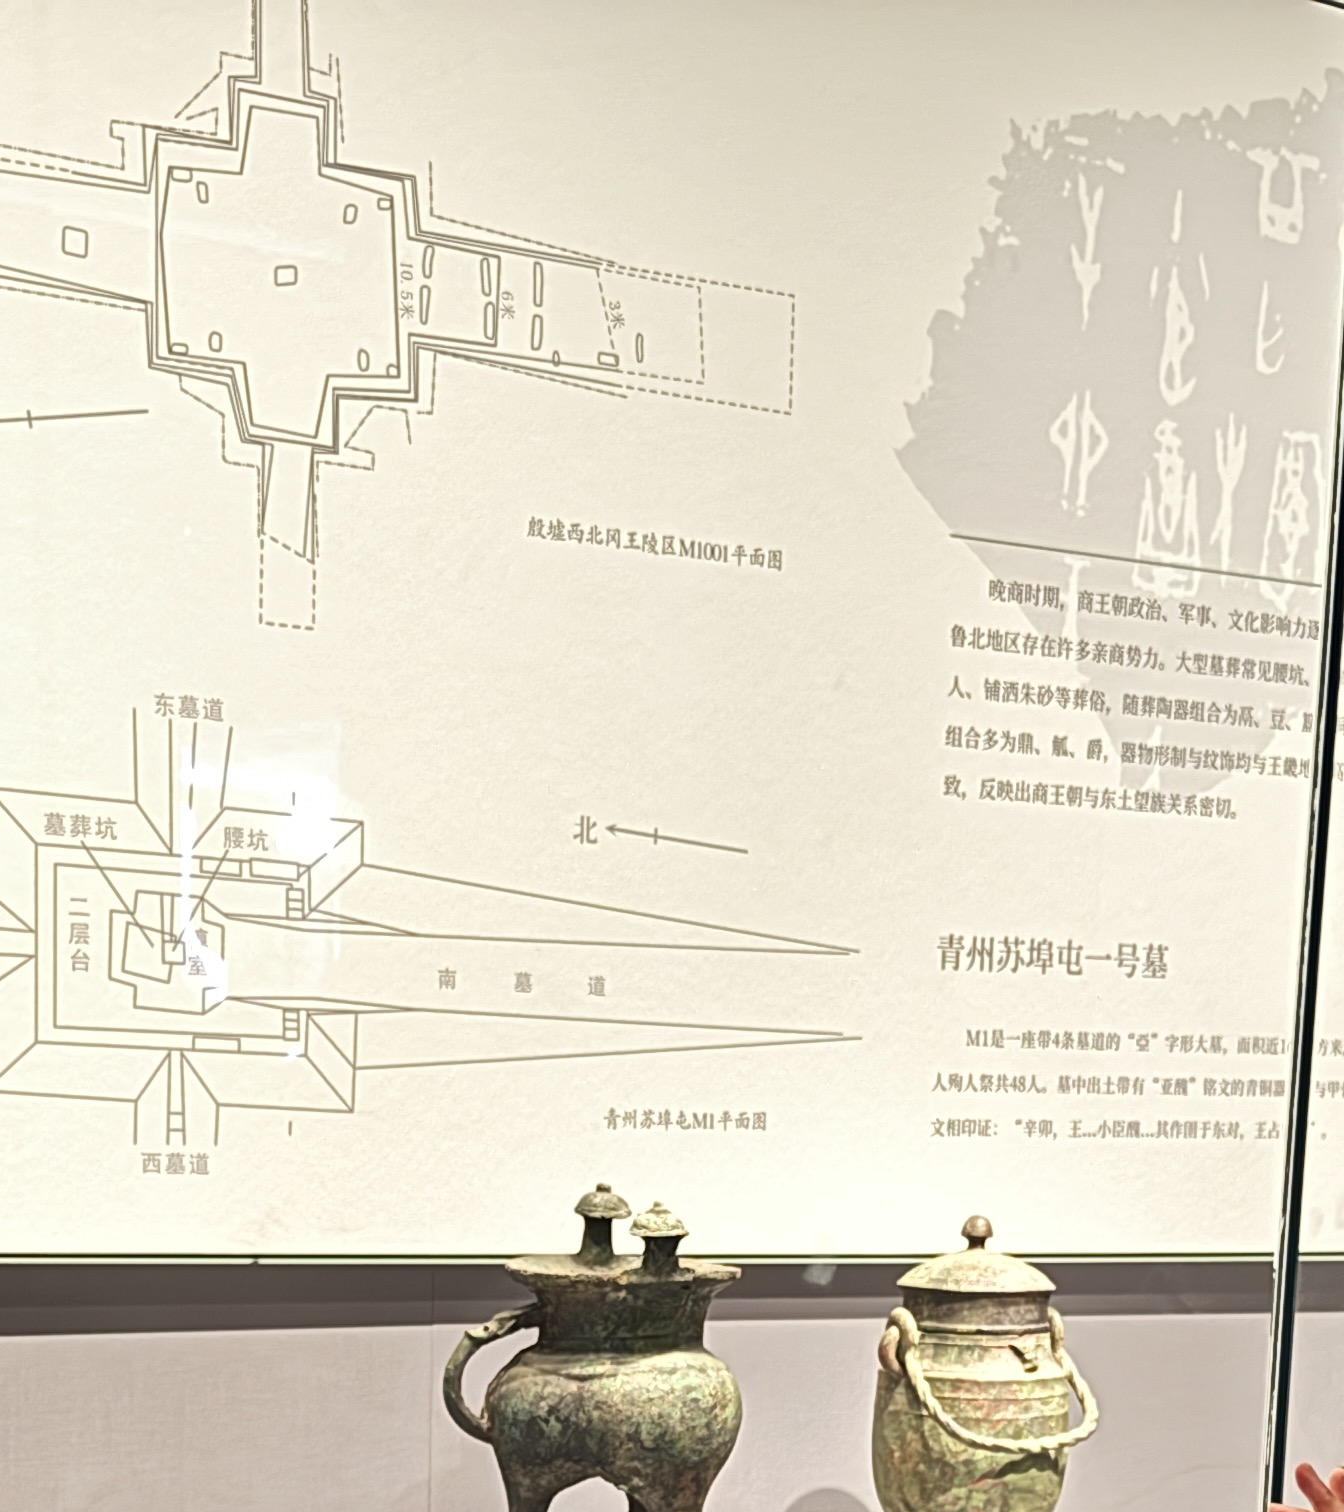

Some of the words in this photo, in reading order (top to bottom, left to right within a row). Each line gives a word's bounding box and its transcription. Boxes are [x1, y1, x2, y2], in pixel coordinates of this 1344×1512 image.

[500, 290, 515, 321] 6米
[608, 300, 626, 330] 3米
[527, 516, 783, 572] 殷墟西北冈王陵区M1001平面图
[154, 692, 225, 723] 东墓道
[43, 812, 119, 841] 墓葬坑
[223, 826, 269, 852] 腰坑
[573, 814, 598, 845] 北
[68, 896, 91, 973] 二层台
[937, 933, 1170, 980] 青州苏埠屯一号墓
[603, 1107, 767, 1131] 青州苏埠屯M1平面图
[141, 1152, 210, 1176] 西墓道
